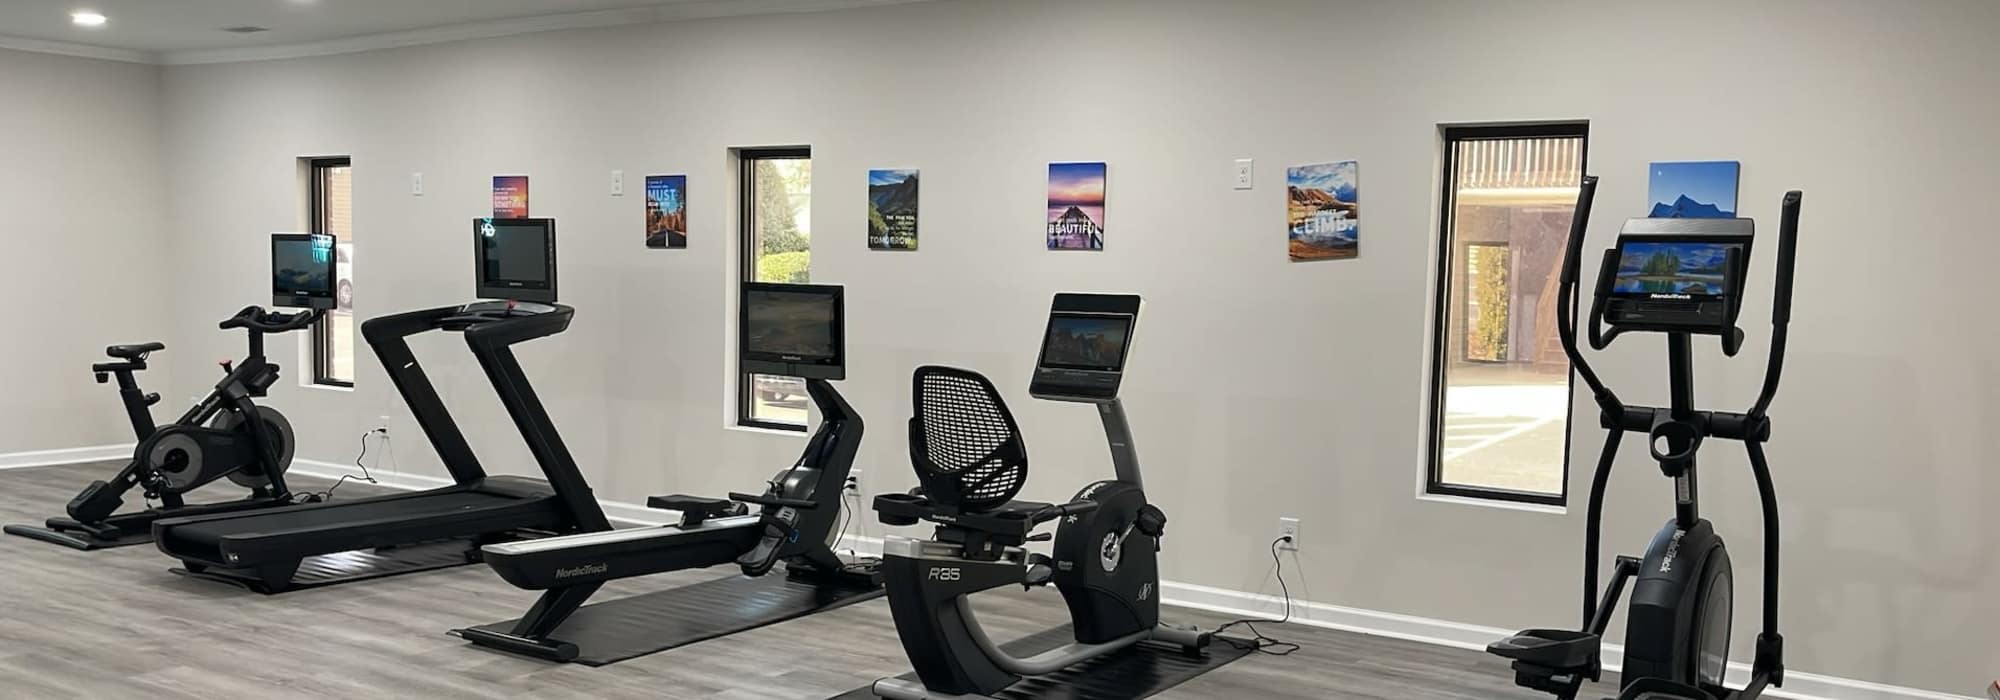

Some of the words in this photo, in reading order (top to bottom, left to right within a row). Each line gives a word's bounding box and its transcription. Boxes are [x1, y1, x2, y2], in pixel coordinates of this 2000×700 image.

[648, 189, 676, 201] MUST
[1048, 223, 1101, 234] BEAUTIFUL
[555, 563, 608, 579] NordicTrack
